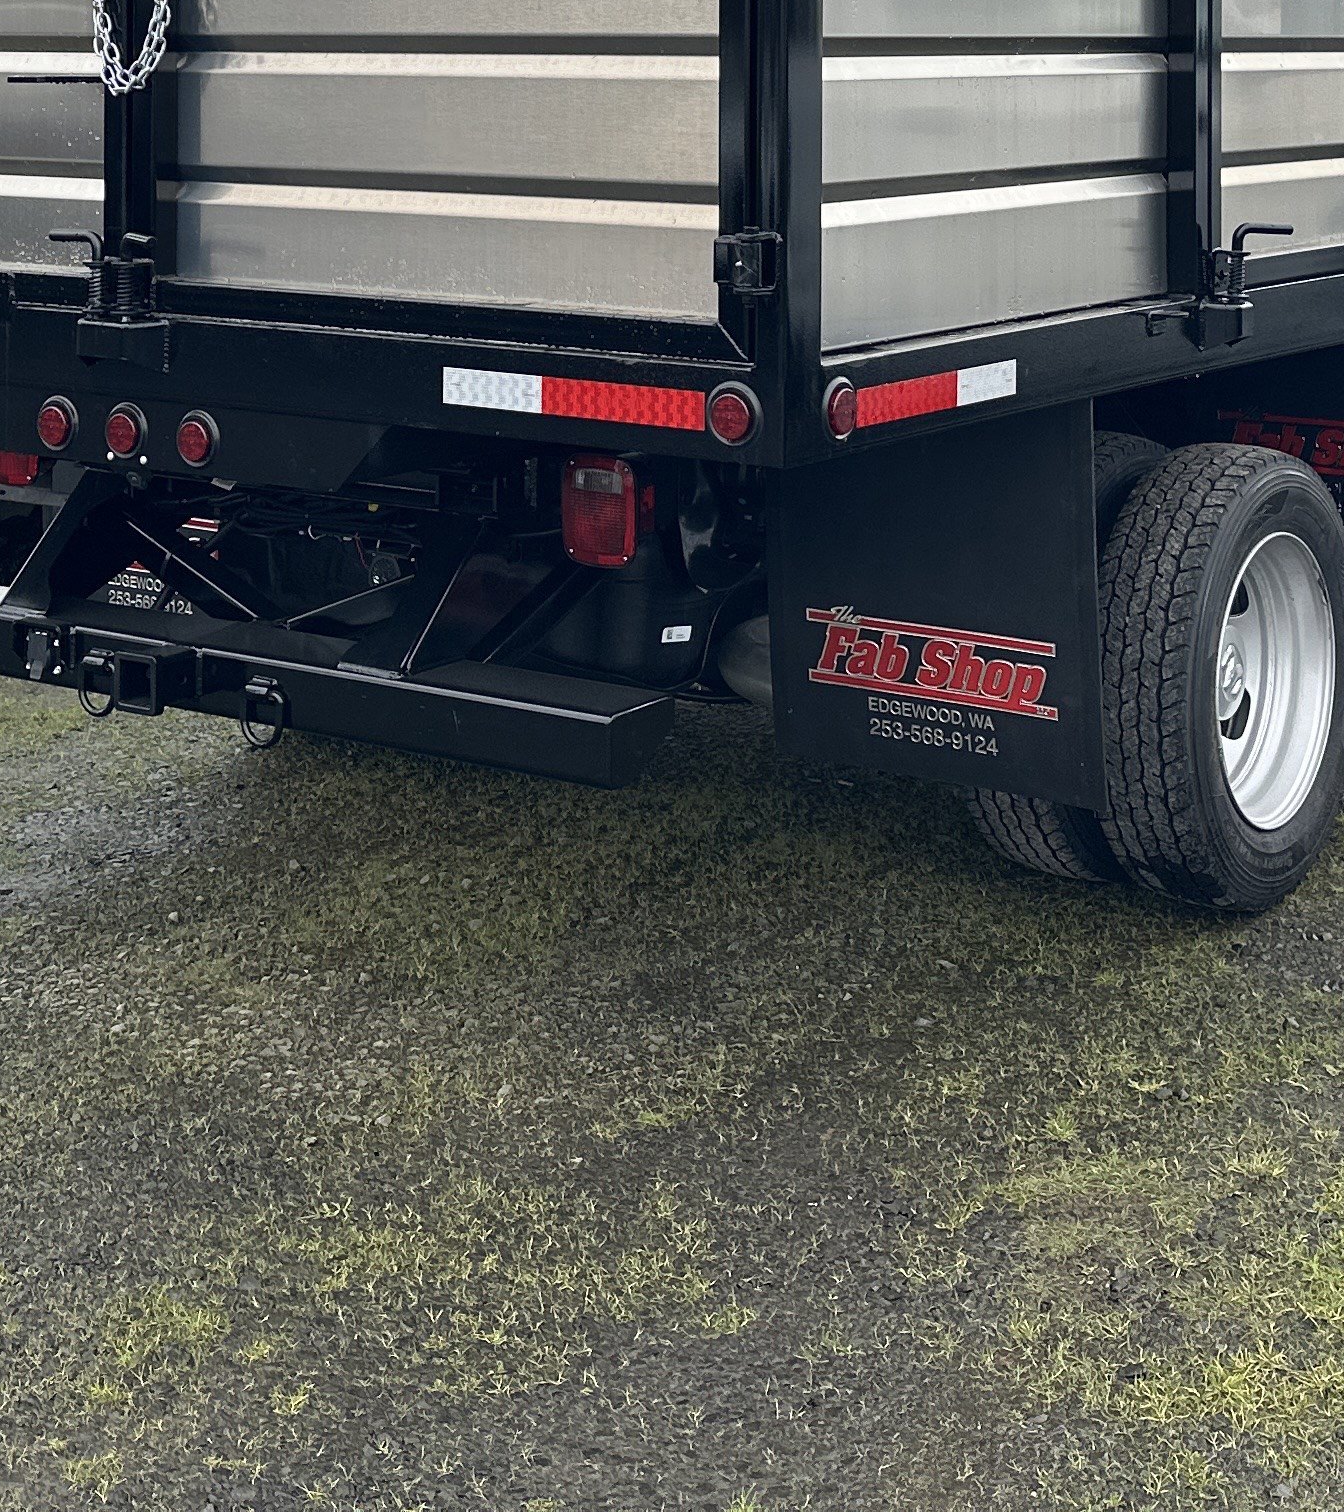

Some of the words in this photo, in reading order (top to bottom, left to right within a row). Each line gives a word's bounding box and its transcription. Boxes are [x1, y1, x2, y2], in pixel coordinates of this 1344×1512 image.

[108, 573, 164, 593] DGEWOO
[830, 605, 862, 623] The
[816, 624, 909, 682] Fab
[915, 638, 1047, 707] Shop
[867, 696, 965, 727] EDGEWOOD,
[968, 712, 995, 731] WA
[869, 719, 999, 757] 253-568-9124
